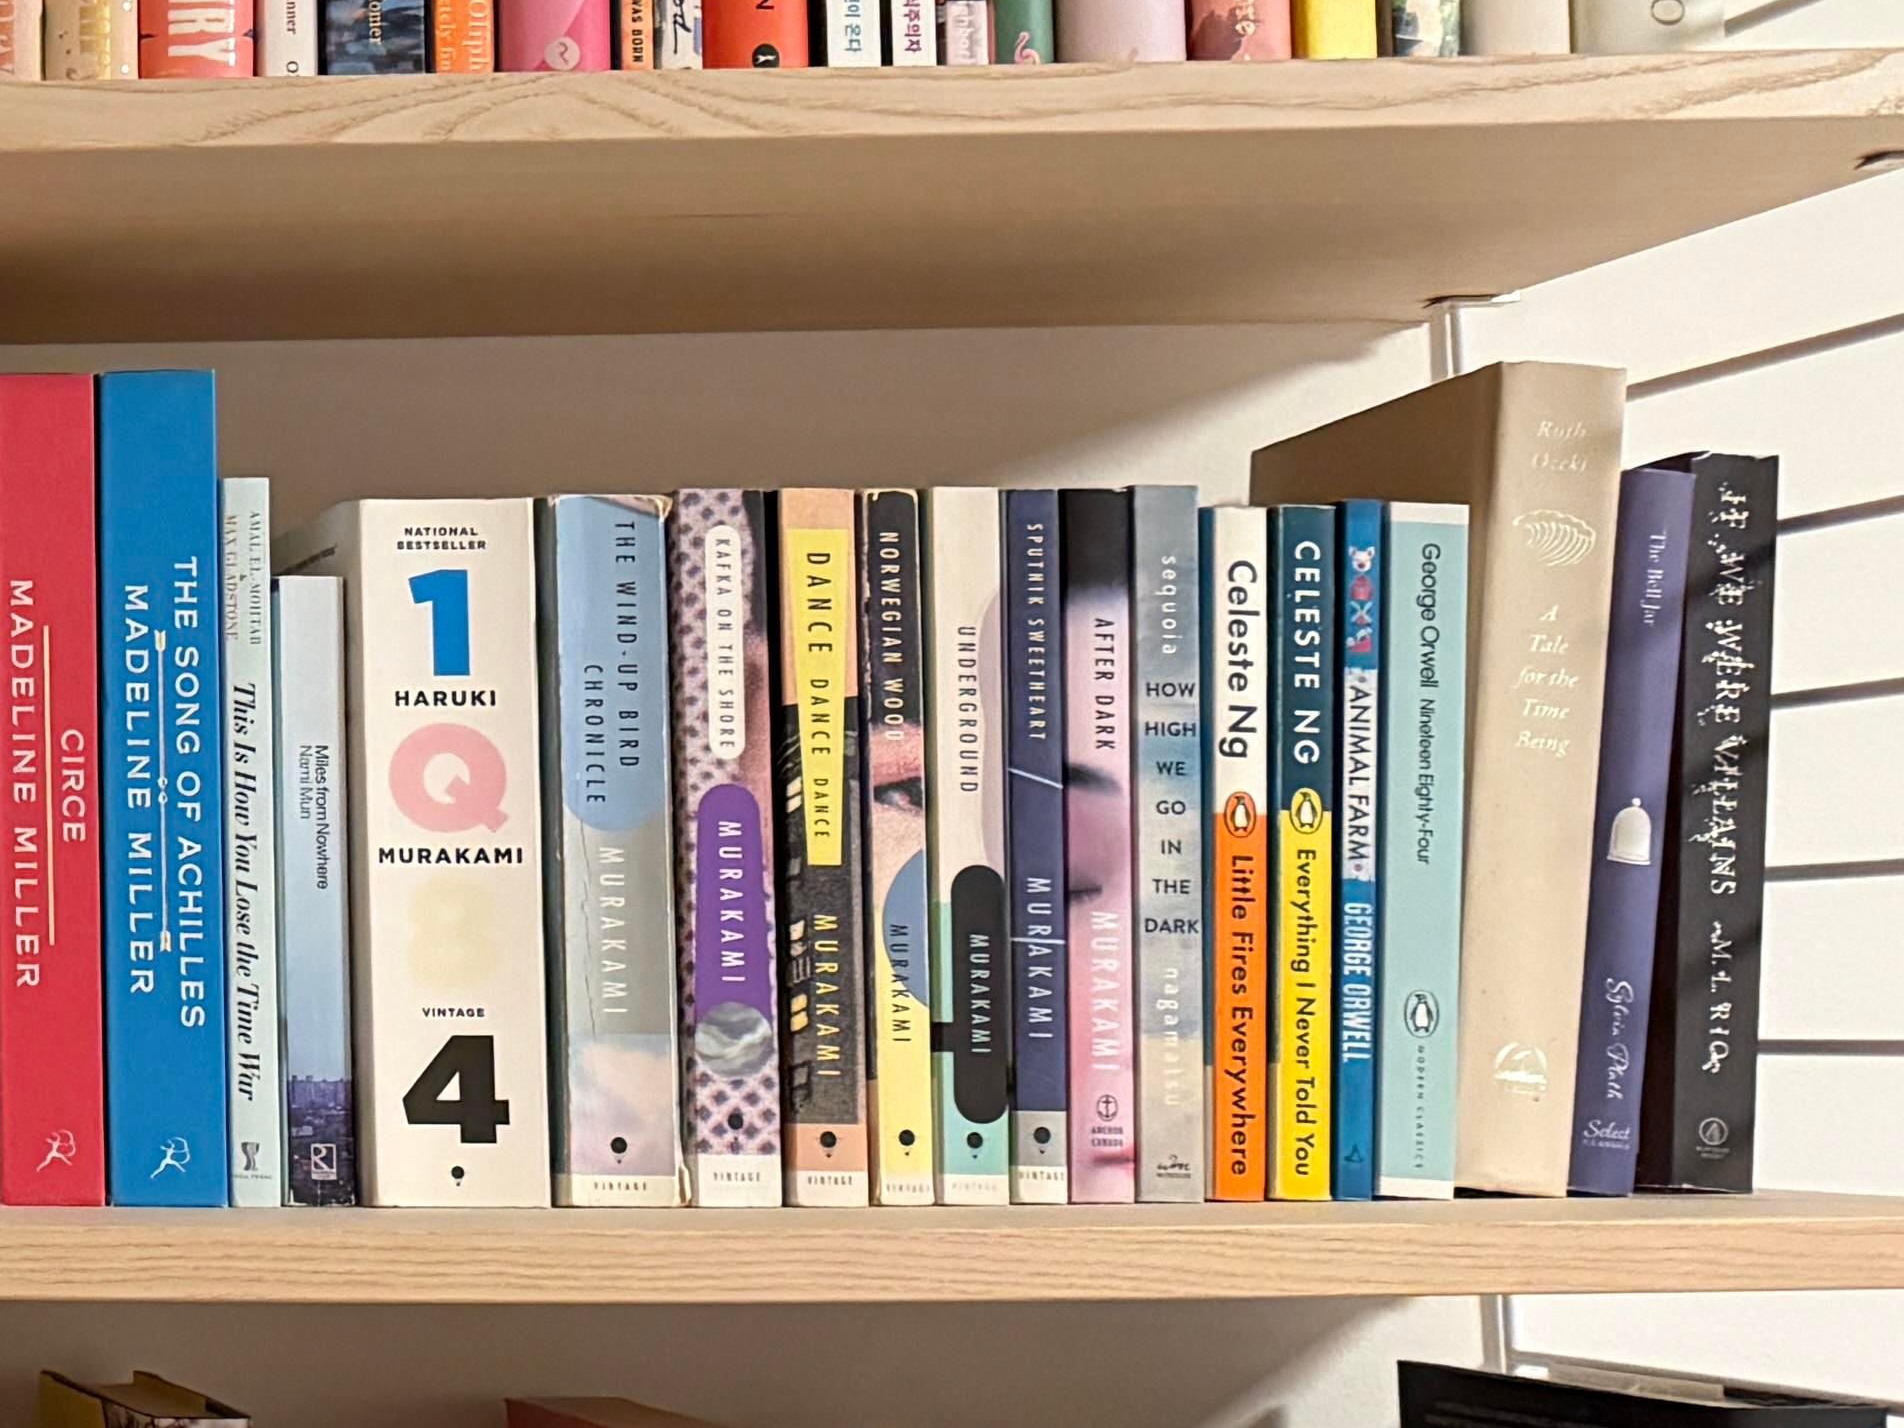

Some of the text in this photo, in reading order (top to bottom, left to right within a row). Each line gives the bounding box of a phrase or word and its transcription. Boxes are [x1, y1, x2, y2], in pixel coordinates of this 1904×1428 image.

[404, 527, 480, 538] NATIONAL
[395, 539, 488, 551] BESTSELLER
[408, 569, 473, 677] 1
[1218, 559, 1259, 760] Celeste Ng
[1145, 683, 1196, 697] HOW
[394, 690, 497, 708] HARUKI
[1144, 722, 1199, 737] HIGH
[1156, 761, 1187, 775] WE
[7, 579, 44, 990] MADELINE MILLER
[58, 728, 87, 844] CIRCE
[388, 722, 509, 835] Q
[1155, 801, 1186, 816] GO
[1159, 840, 1182, 854] IN
[377, 847, 525, 865] MURAKAMI
[1152, 880, 1190, 894] THE
[717, 820, 748, 986] MURAKAMI
[1144, 919, 1202, 933] DARK
[422, 1007, 485, 1017] VINTAGE
[1228, 854, 1254, 1178] Little Fires Everywhere
[401, 1033, 511, 1145] 4
